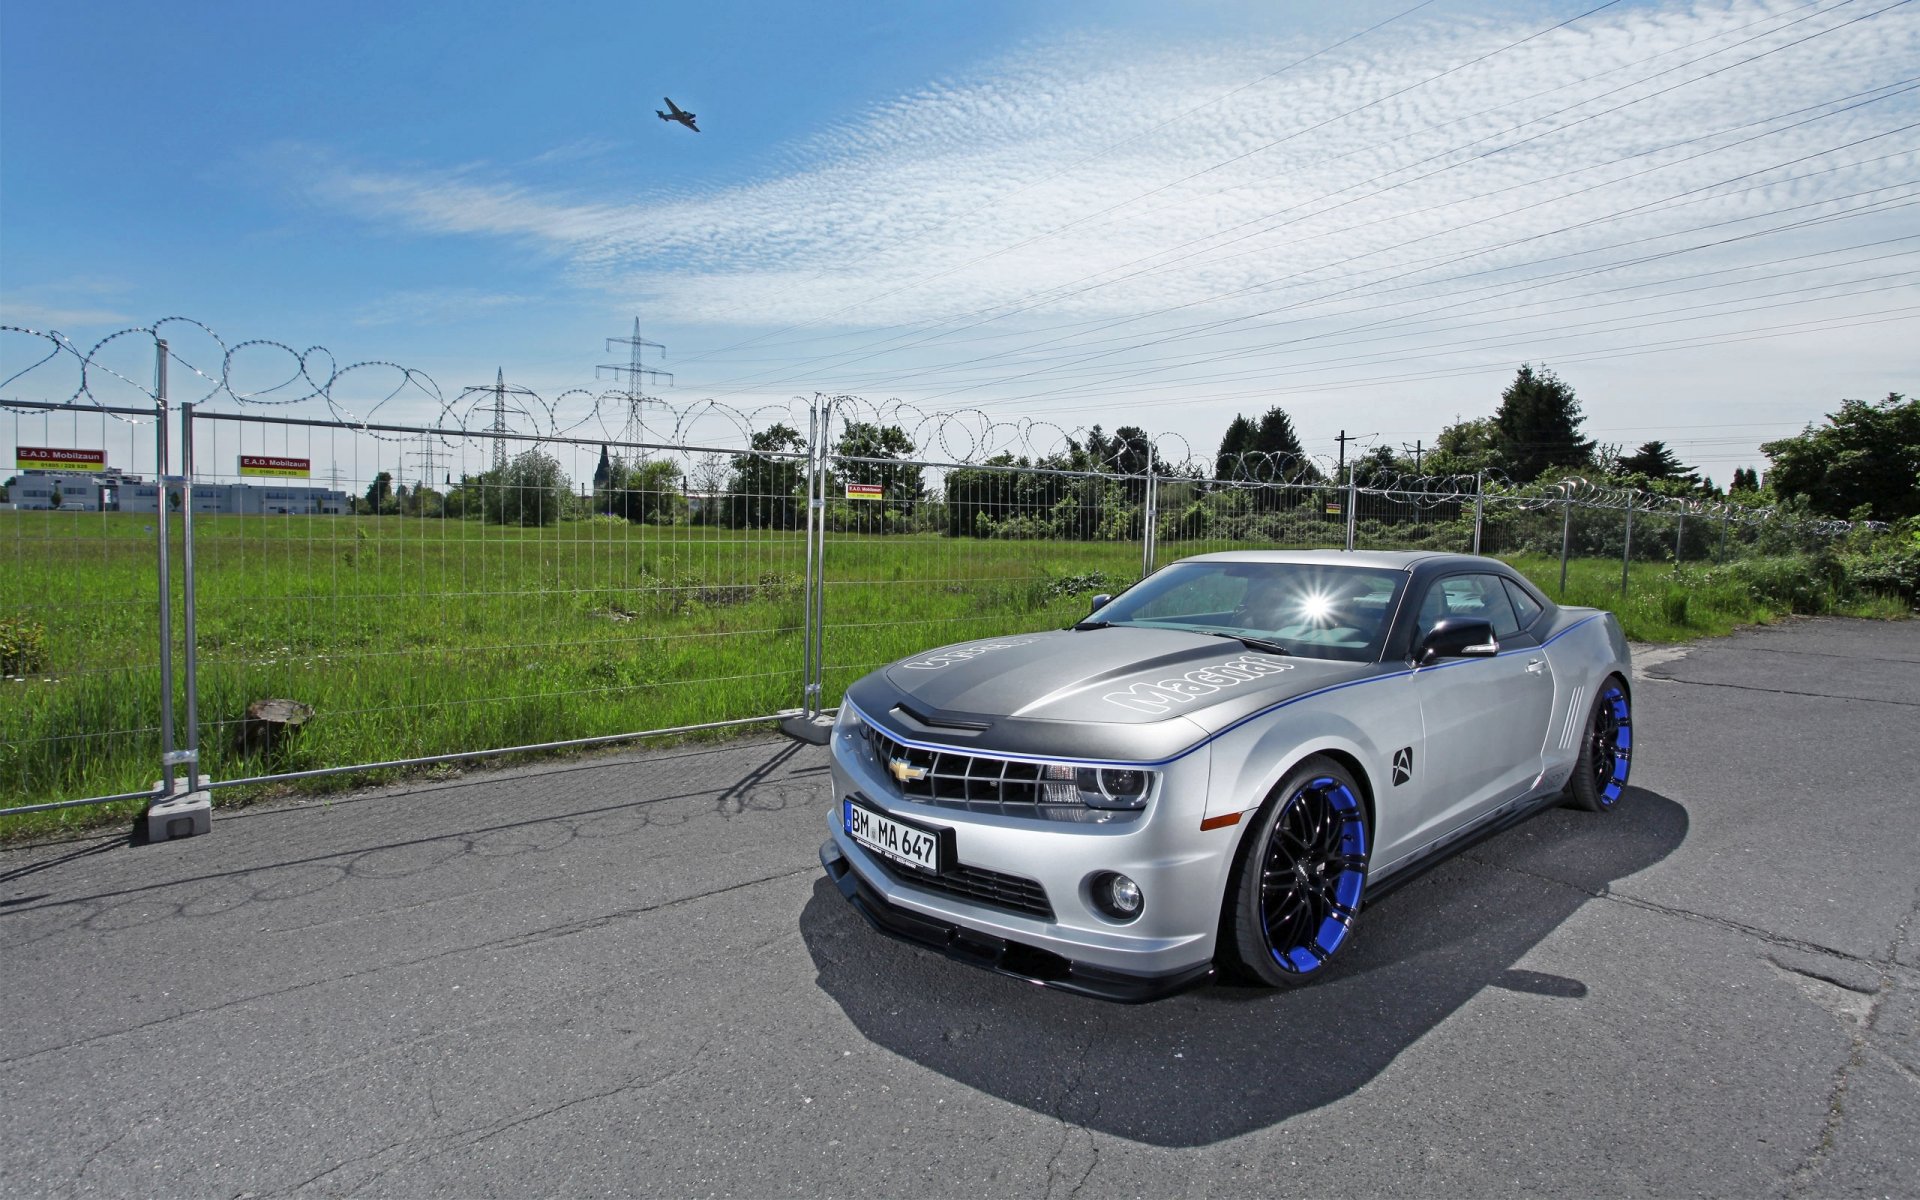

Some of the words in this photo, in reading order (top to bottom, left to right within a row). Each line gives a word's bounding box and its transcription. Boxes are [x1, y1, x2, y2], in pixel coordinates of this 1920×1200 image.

[20, 450, 50, 458] E.A.D.
[52, 451, 100, 460] Mobilzaun
[244, 458, 267, 466] E.A.D.
[269, 459, 307, 467] Mobilzaun
[1102, 655, 1295, 715] Magnat
[852, 808, 869, 838] BM
[878, 819, 898, 851] MA
[902, 830, 934, 863] 647
